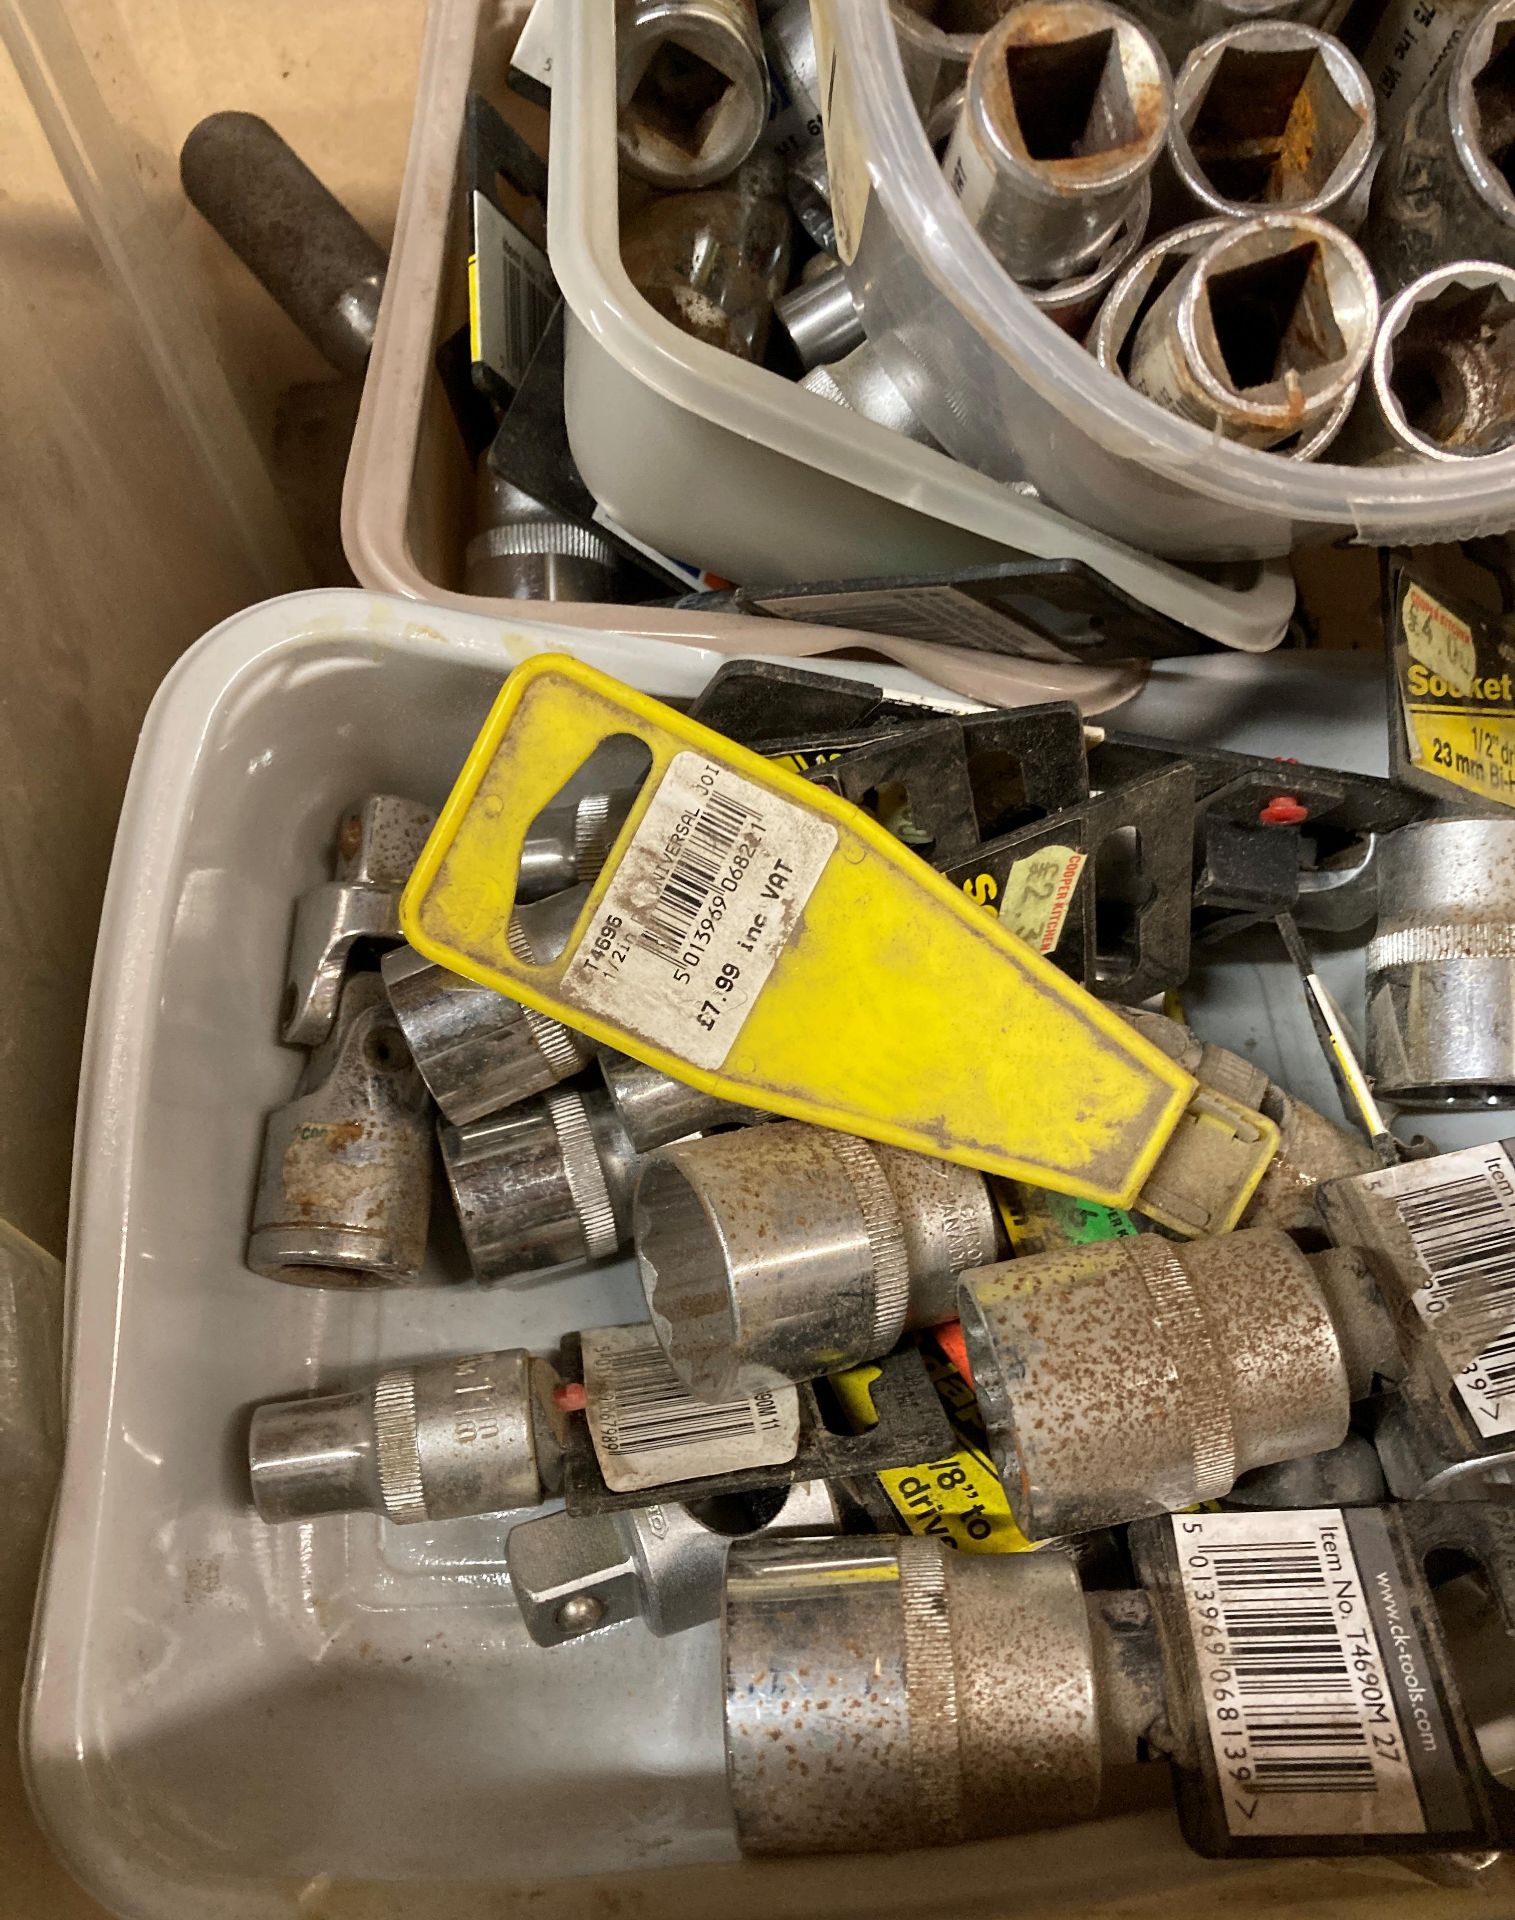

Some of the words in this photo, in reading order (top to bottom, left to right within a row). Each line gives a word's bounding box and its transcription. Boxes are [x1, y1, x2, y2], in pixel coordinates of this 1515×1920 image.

[1432, 737, 1453, 769] 23
[649, 808, 702, 896] UNIVERSAL
[1056, 855, 1081, 905] COOPER
[673, 968, 691, 984] 5
[684, 895, 728, 967] 013969
[721, 821, 767, 892] 06821
[1039, 902, 1068, 952] KITCHEN
[583, 914, 623, 971] T4696
[697, 962, 740, 1031] £7.99
[761, 858, 794, 901] VAT
[1484, 1158, 1514, 1197] Item
[754, 1390, 778, 1417] 90M
[960, 1504, 992, 1540] to
[1182, 1522, 1203, 1534] 5
[1188, 1555, 1227, 1655] 013969
[1318, 1526, 1342, 1572] Item
[1332, 1580, 1357, 1619] No.
[1346, 1628, 1390, 1724] T4690M
[1372, 1733, 1401, 1763] 27
[1376, 1571, 1437, 1752] www.ck-tools.com
[1209, 1668, 1253, 1781] 068139
